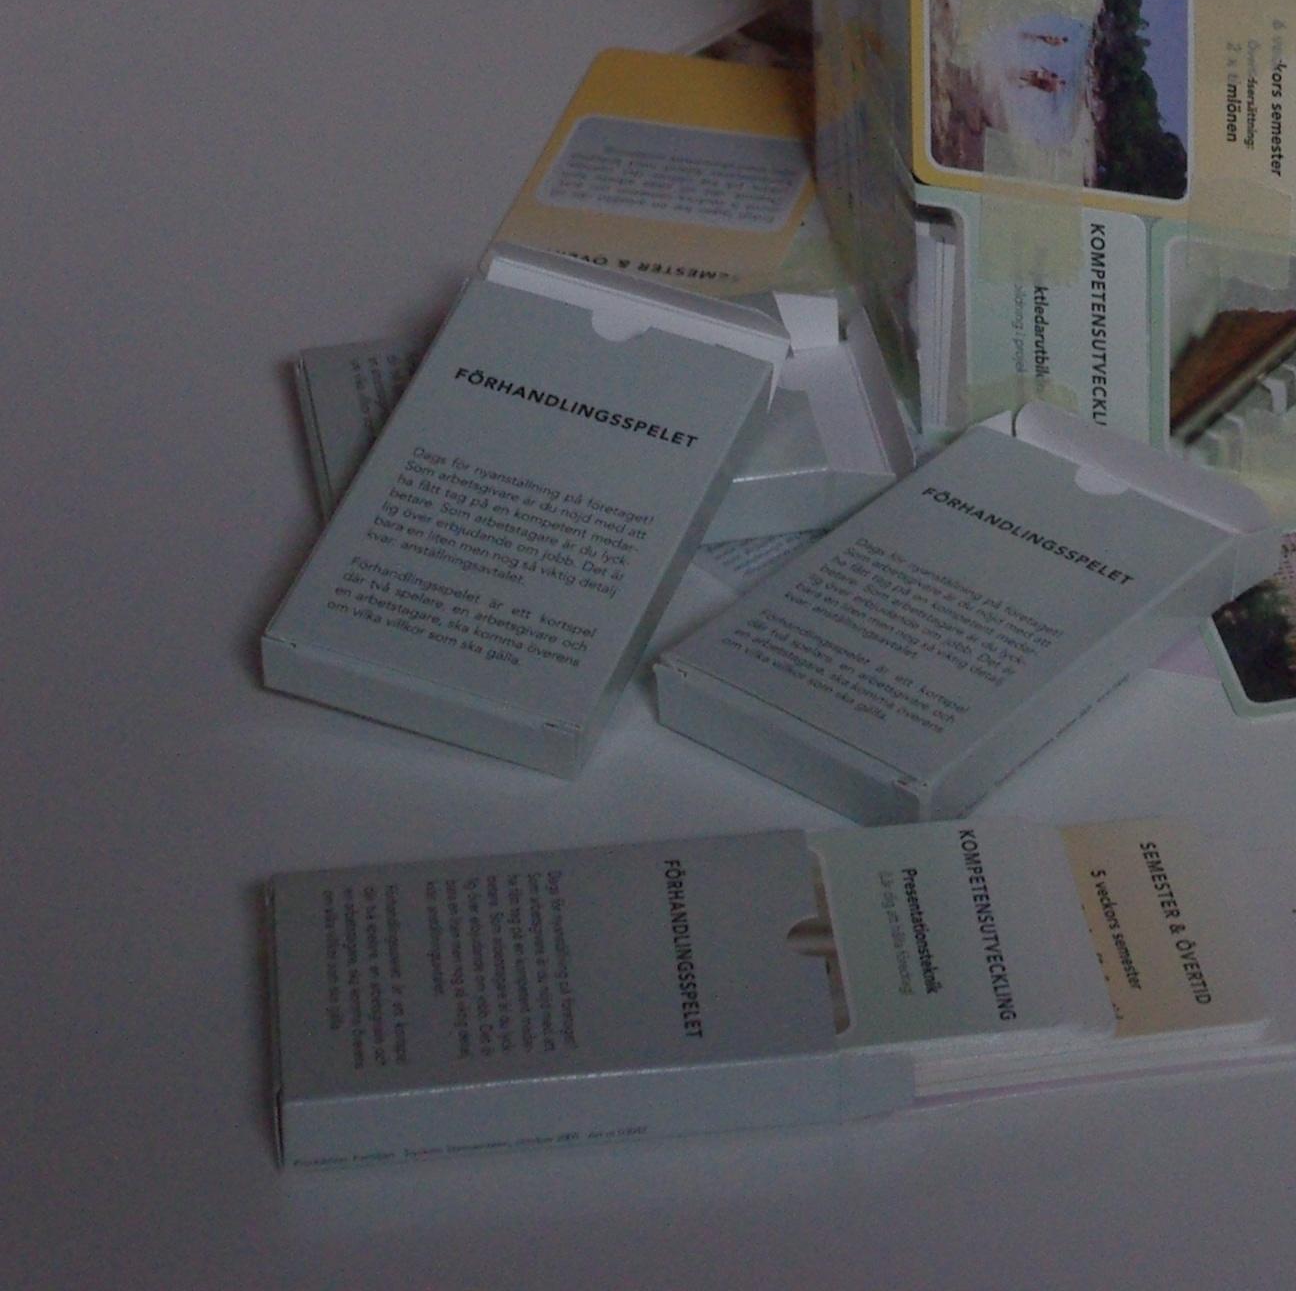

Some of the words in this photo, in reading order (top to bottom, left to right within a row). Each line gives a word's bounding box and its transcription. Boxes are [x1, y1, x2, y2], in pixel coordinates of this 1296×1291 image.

[1271, 103, 1285, 177] semester
[1089, 223, 1107, 426] KOMPETENSUTVECKLI
[455, 365, 699, 449] FÖRHANDLINGSSPELET
[921, 485, 1135, 586] FÖRHANDLINGSSPELET
[663, 858, 703, 1039] FÖRHANDLINGSSPELET
[901, 867, 940, 996] Presentationsteknik
[959, 828, 1016, 1022] KOMPETENSUTVECKLING
[1095, 880, 1122, 930] veckors
[1111, 931, 1144, 991] semester
[1140, 840, 1179, 922] SEMESTER
[1168, 923, 1182, 936] &
[1175, 937, 1213, 1006] ÖVERTID
